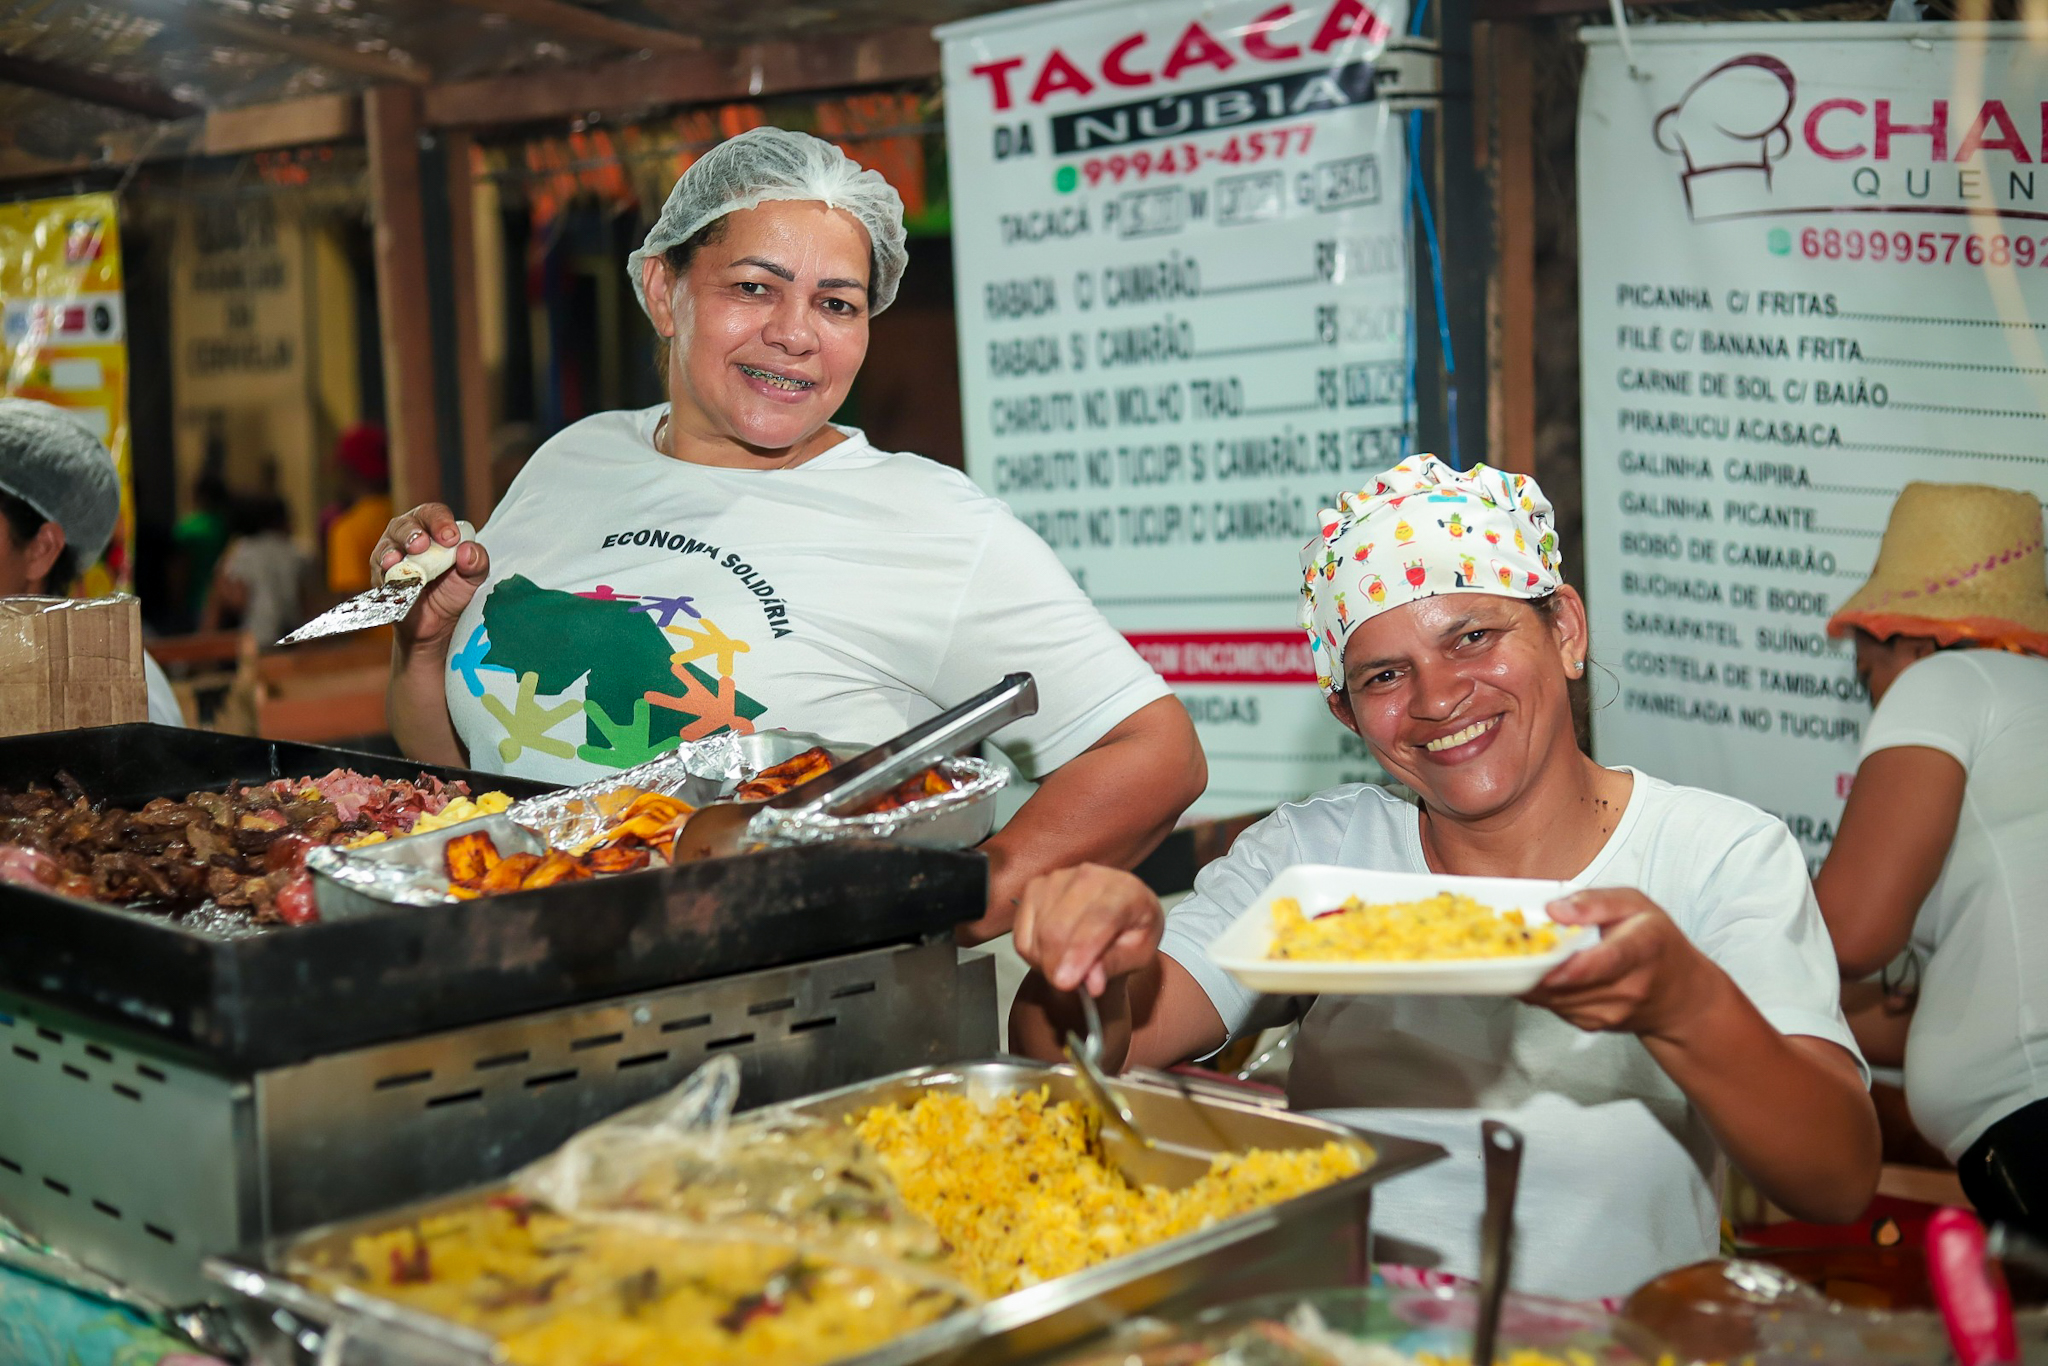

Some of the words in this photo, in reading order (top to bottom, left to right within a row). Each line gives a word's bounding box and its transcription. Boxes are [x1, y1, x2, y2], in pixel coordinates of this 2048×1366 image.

[993, 121, 1034, 161] DA
[1073, 76, 1350, 150] NÚBIA
[1082, 125, 1315, 188] 99943-4577
[1616, 283, 1713, 311] PICANHA
[1757, 290, 1839, 319] FRITAS
[1617, 322, 1663, 352] FILÉ
[1700, 330, 1791, 361] BANANA
[1797, 336, 1863, 363] FRITA
[1616, 366, 1694, 397] CARNE
[1698, 371, 1731, 399] DE
[1734, 373, 1778, 404] SOL
[1814, 374, 1888, 408] BAIÃO
[1617, 407, 1731, 440] PIRARUCU
[1735, 417, 1843, 447] ACASACA
[1618, 448, 1714, 481] GALINHA
[1723, 456, 1812, 488] CAIPIRA
[1618, 490, 1714, 522] GALINHA
[1723, 499, 1817, 532] PICANTE
[1687, 536, 1718, 564] DE
[1722, 540, 1837, 576] CAMARÃO
[720, 553, 794, 639] SOLIDÁRIA
[1620, 571, 1724, 604] BUCHADA
[1729, 582, 1760, 610] DE
[1766, 587, 1829, 617] BODE
[1622, 610, 1744, 650] SARAPATEL
[1622, 650, 1720, 686] COSTELA
[1722, 662, 1753, 690] DE
[1624, 689, 1734, 726] PANELADA
[1738, 706, 1773, 734] NO
